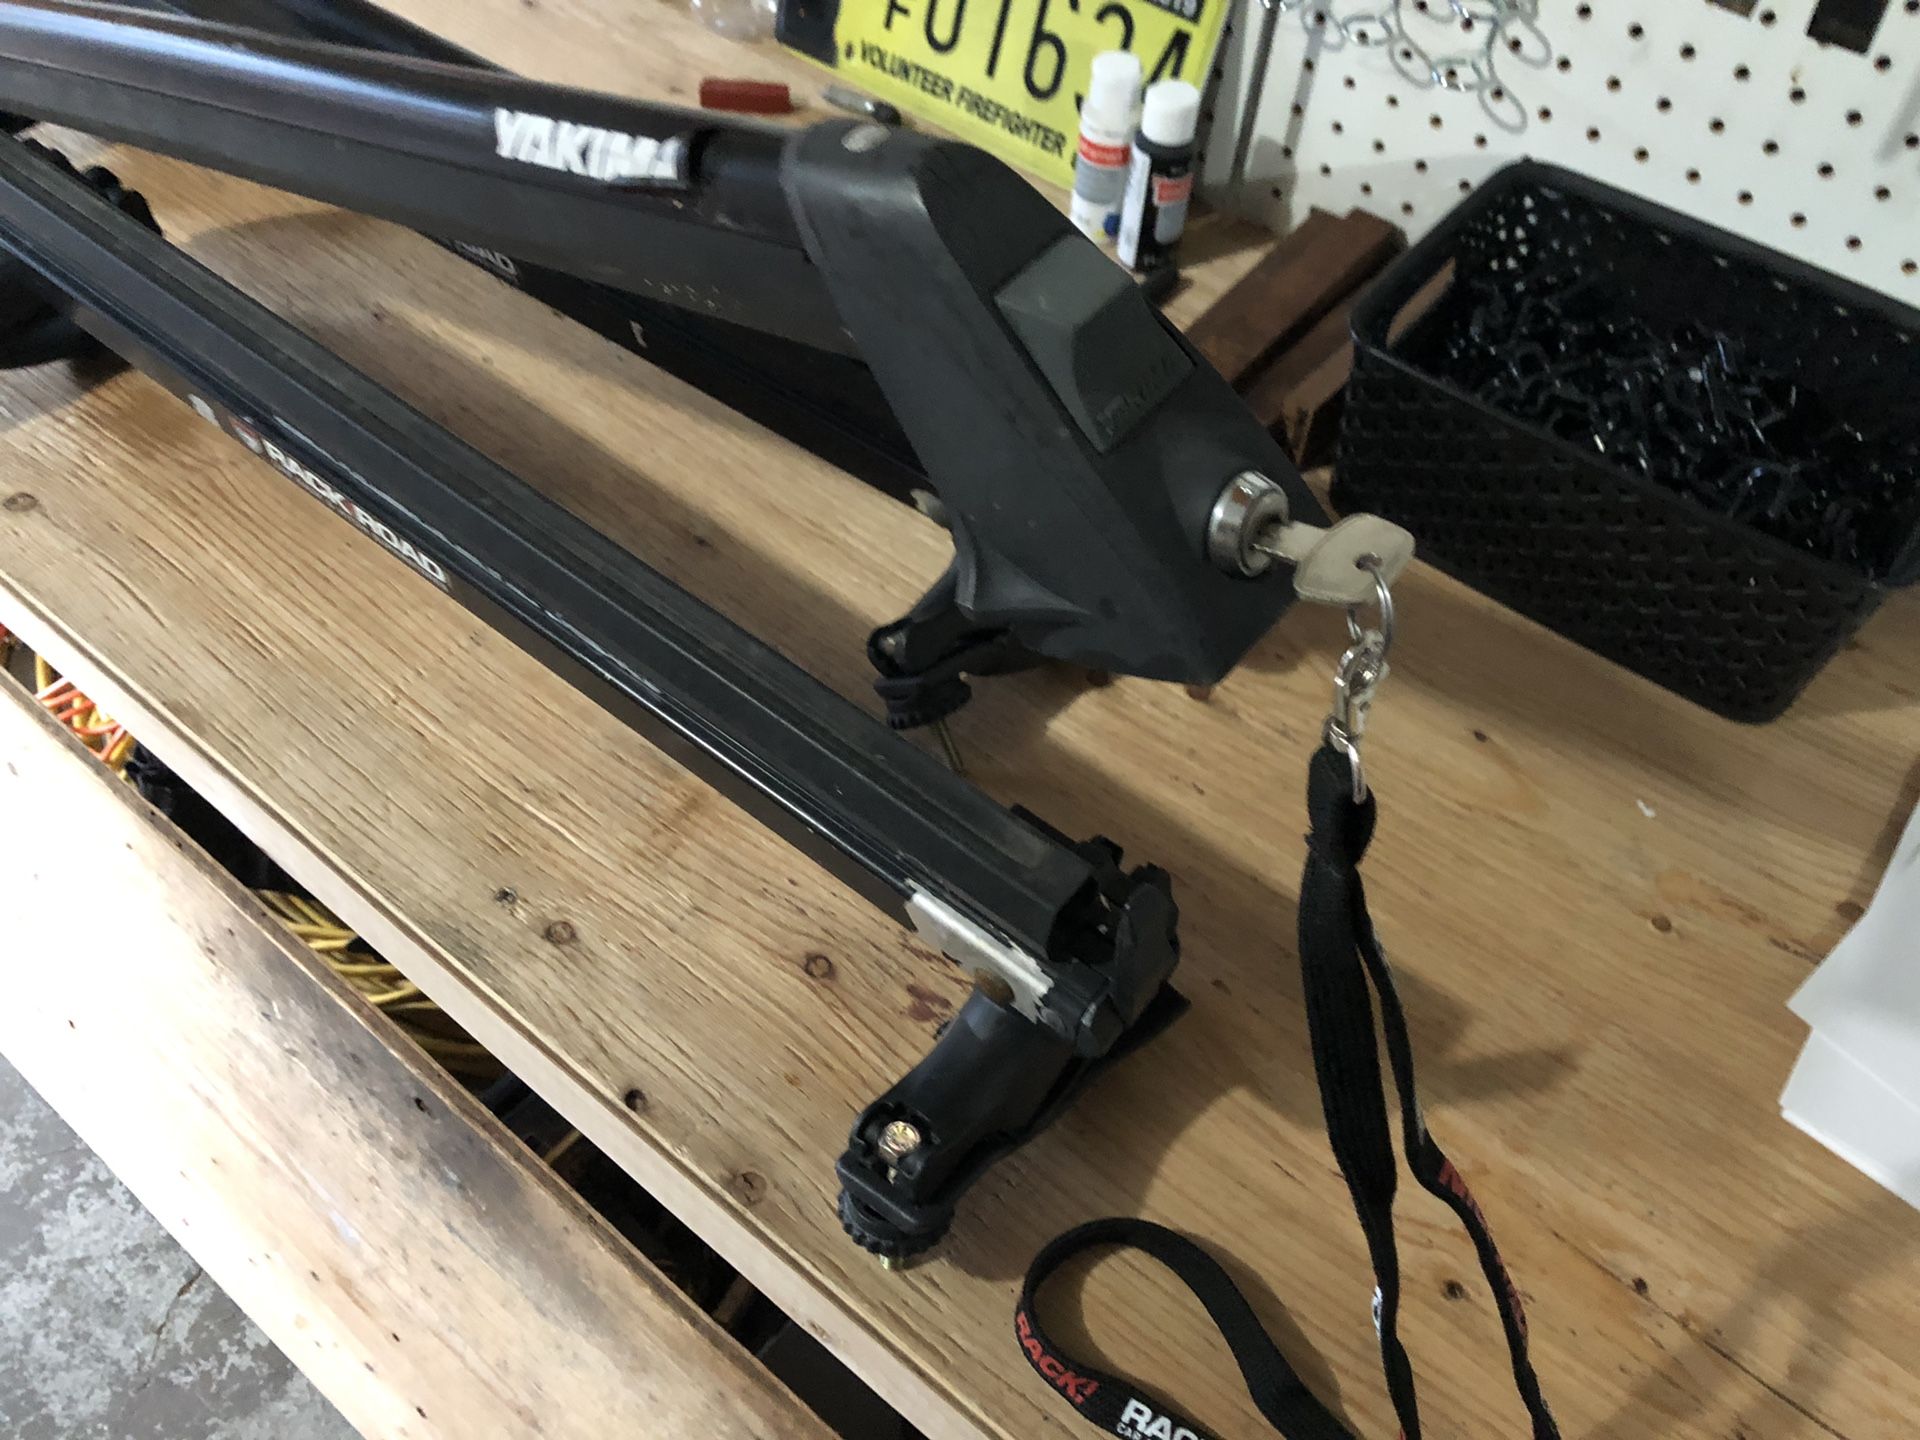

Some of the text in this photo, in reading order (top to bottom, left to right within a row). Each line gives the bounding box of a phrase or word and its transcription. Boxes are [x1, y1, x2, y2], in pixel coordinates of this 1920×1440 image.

[861, 39, 954, 102] VOLUNTEER
[956, 85, 1067, 158] FIREFIGHTER
[494, 106, 679, 181] YAKIMA
[1016, 1310, 1099, 1404] RACK!
[1120, 1397, 1206, 1440] RAC
